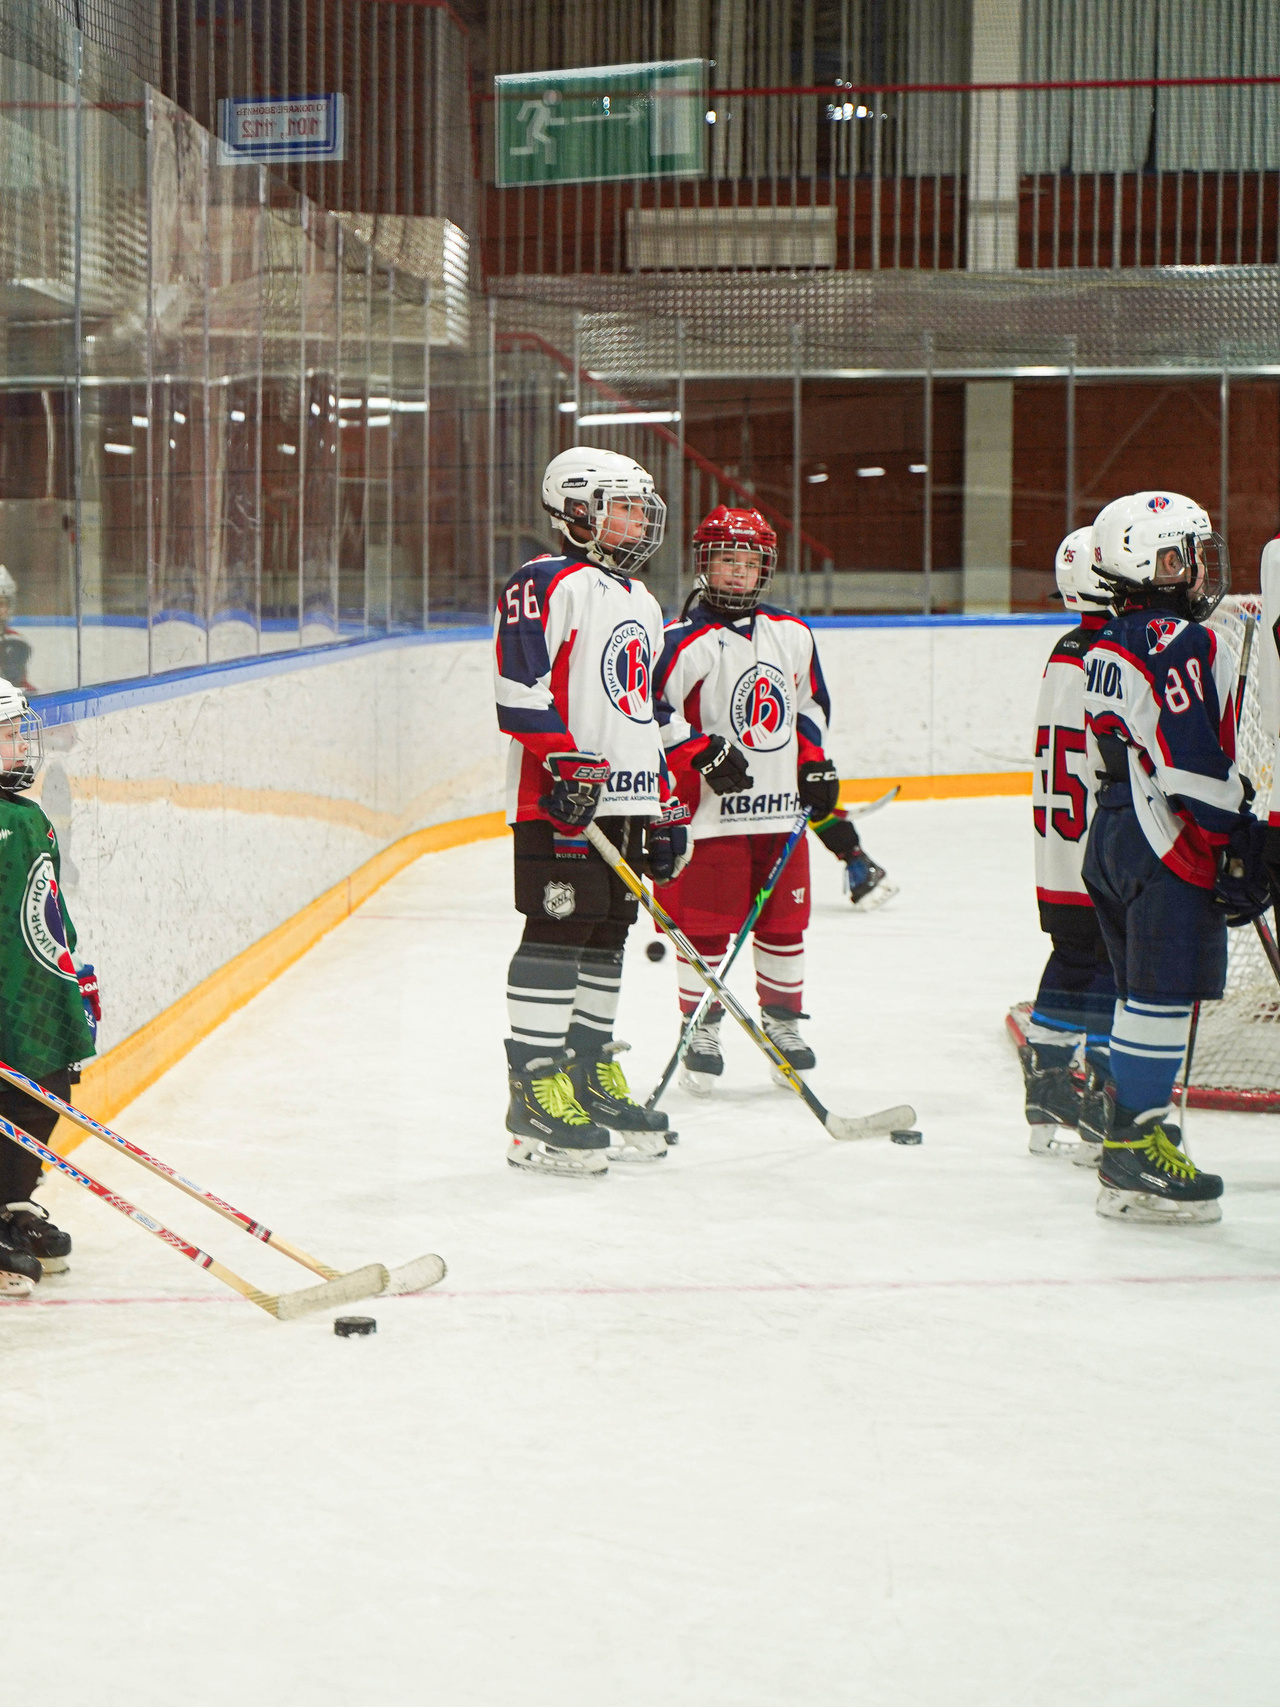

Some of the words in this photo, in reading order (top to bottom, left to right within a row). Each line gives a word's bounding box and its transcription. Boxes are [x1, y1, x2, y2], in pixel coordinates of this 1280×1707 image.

[1158, 531, 1185, 539] CCM
[505, 578, 541, 624] 56
[765, 669, 785, 689] CLUB
[1164, 657, 1204, 714] 88
[700, 738, 732, 776] CCM
[31, 912, 57, 959] VIKHR
[5, 1070, 126, 1145] Atom
